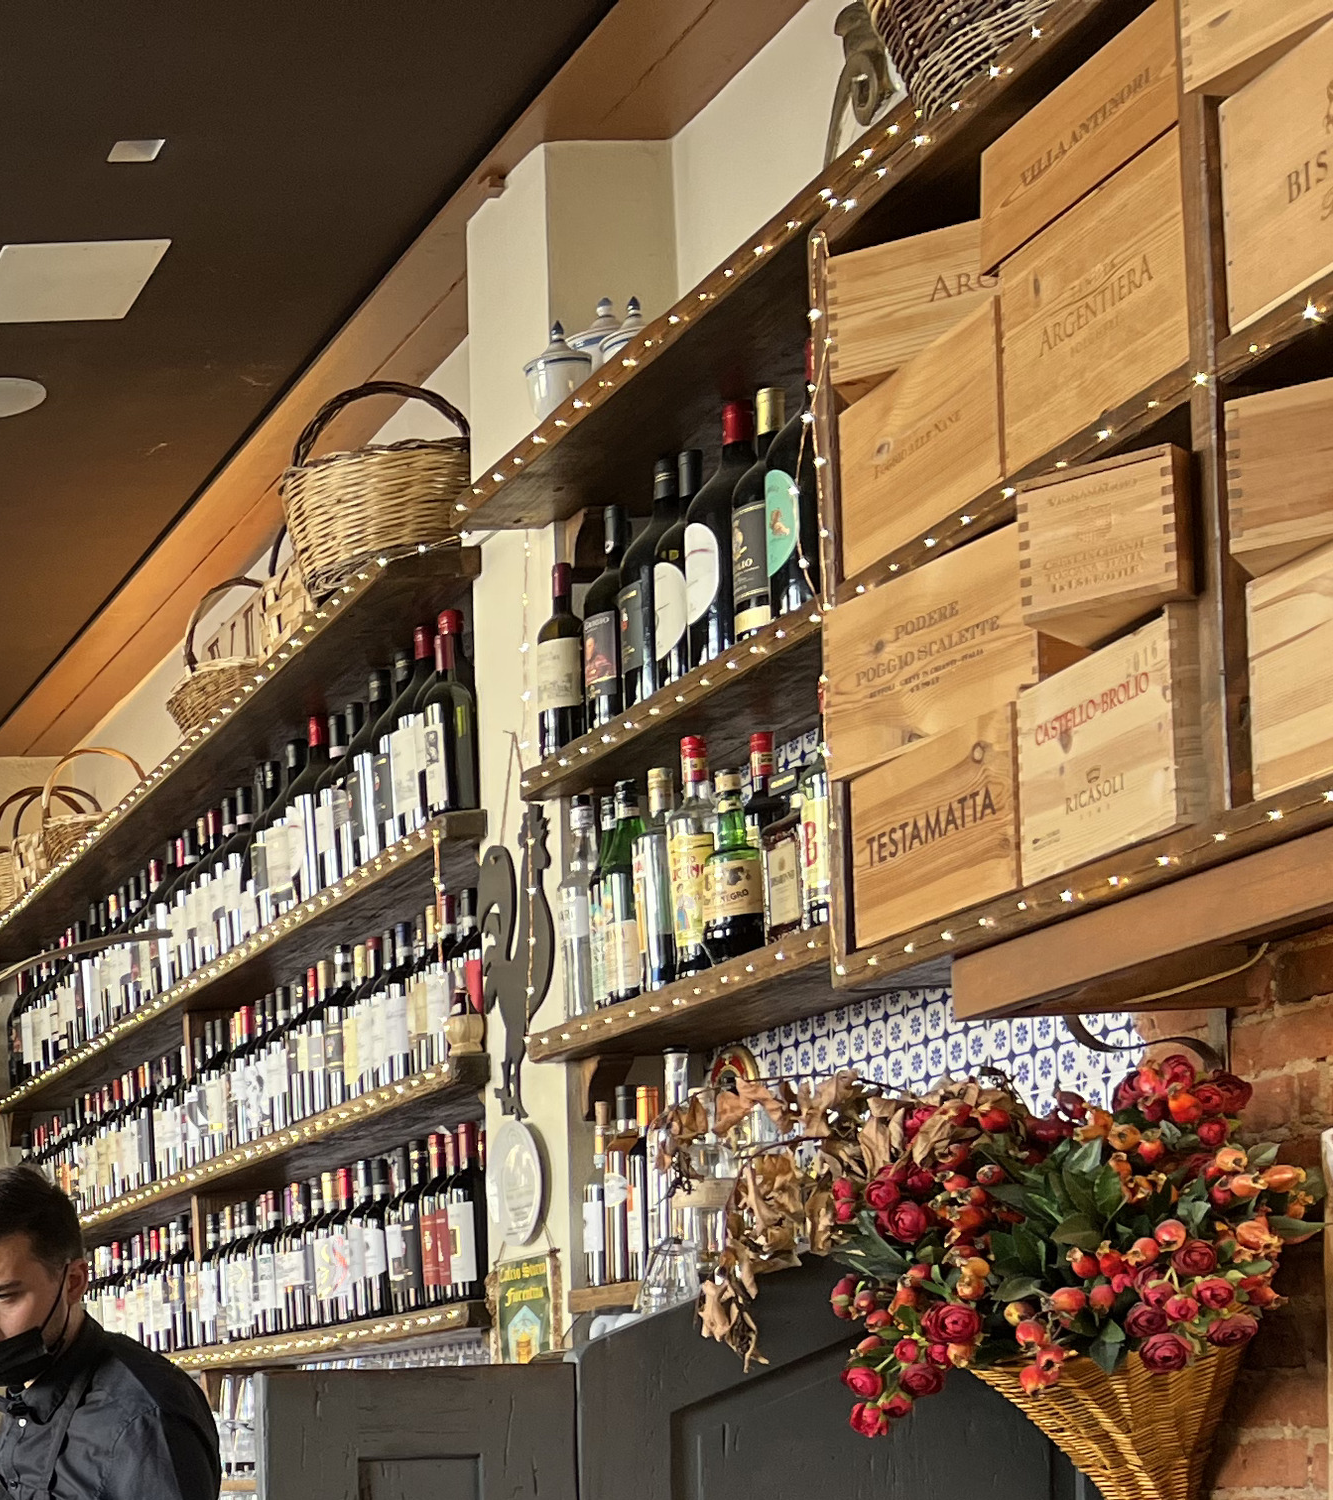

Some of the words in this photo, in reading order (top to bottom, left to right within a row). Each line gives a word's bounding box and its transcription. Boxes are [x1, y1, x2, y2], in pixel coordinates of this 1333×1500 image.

[1020, 140, 1068, 187] VILLA
[1038, 253, 1154, 359] ARGENTIERA
[855, 650, 916, 688] POGGIO
[917, 615, 1001, 661] SCALETTE
[893, 600, 960, 642] PODERE
[1034, 697, 1096, 747] CASTELLO
[1100, 671, 1151, 715] BROLIO
[865, 787, 997, 868] TESTAMATTA
[1064, 773, 1126, 816] RICASOLI
